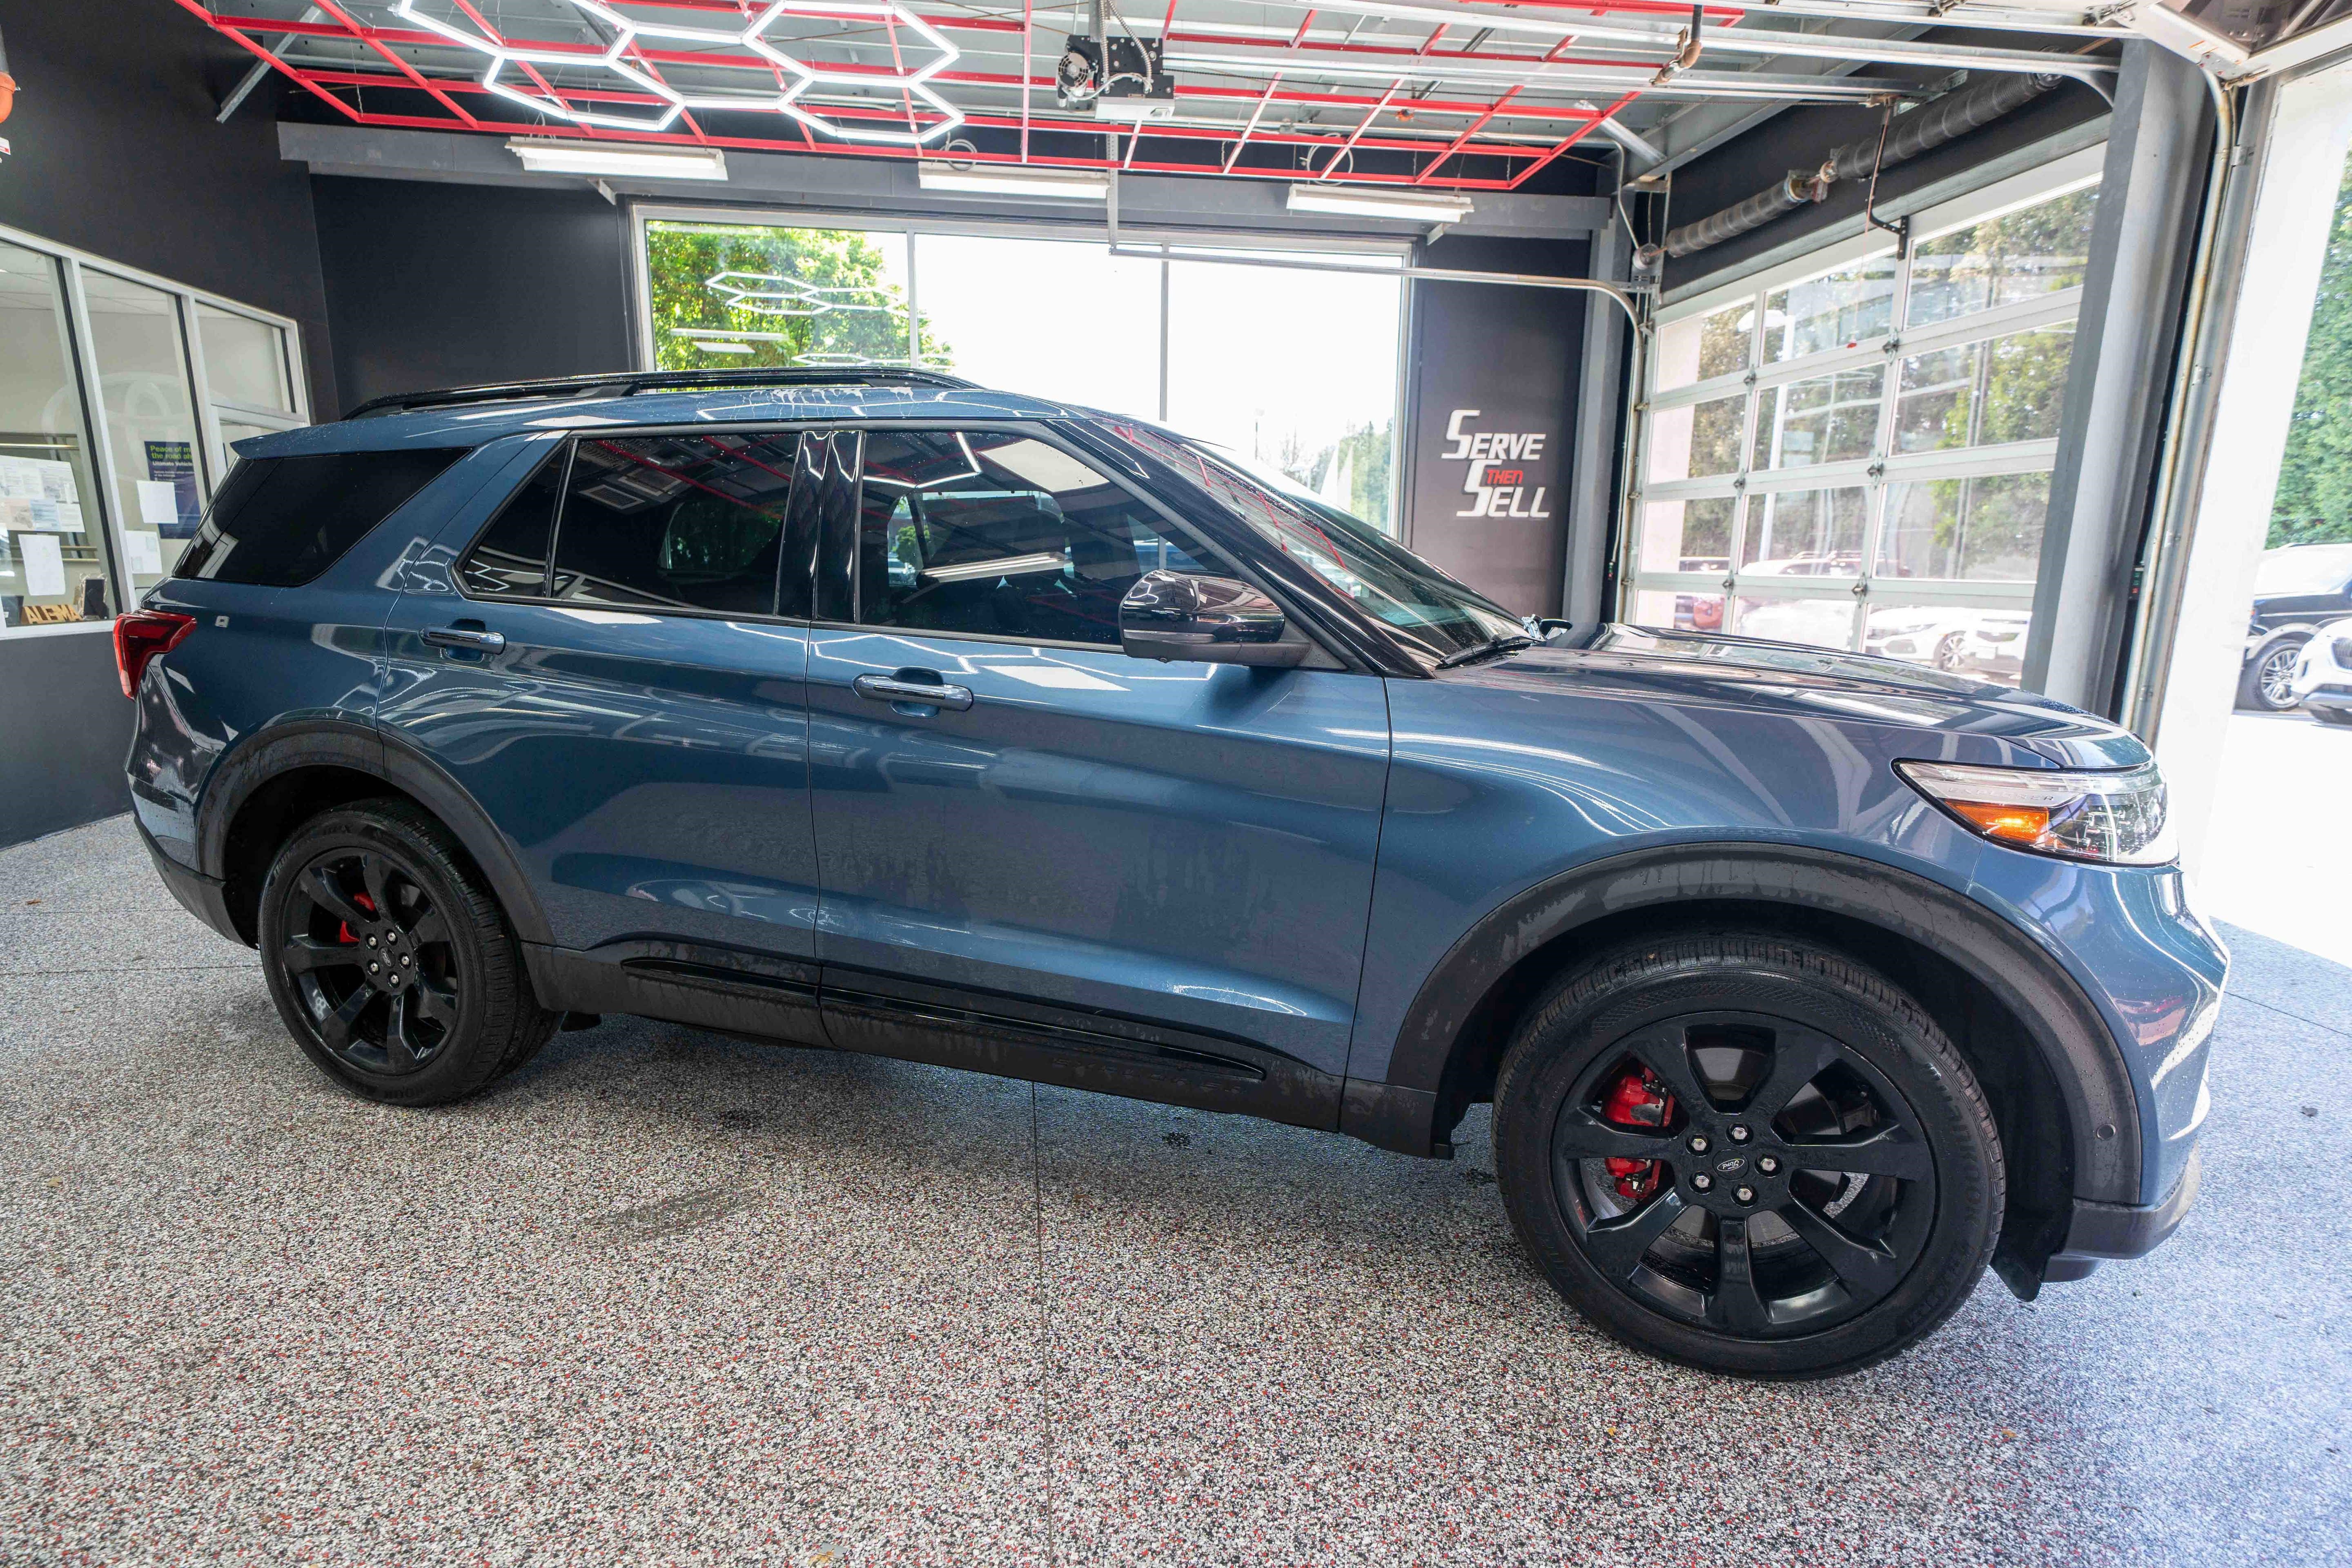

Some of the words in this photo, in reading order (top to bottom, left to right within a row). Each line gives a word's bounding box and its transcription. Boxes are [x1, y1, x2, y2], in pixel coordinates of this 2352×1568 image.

[1441, 410, 1546, 460] SERVE
[1456, 459, 1550, 517] SELL
[1487, 470, 1523, 484] THEN
[1948, 787, 2054, 801] EXPLORER
